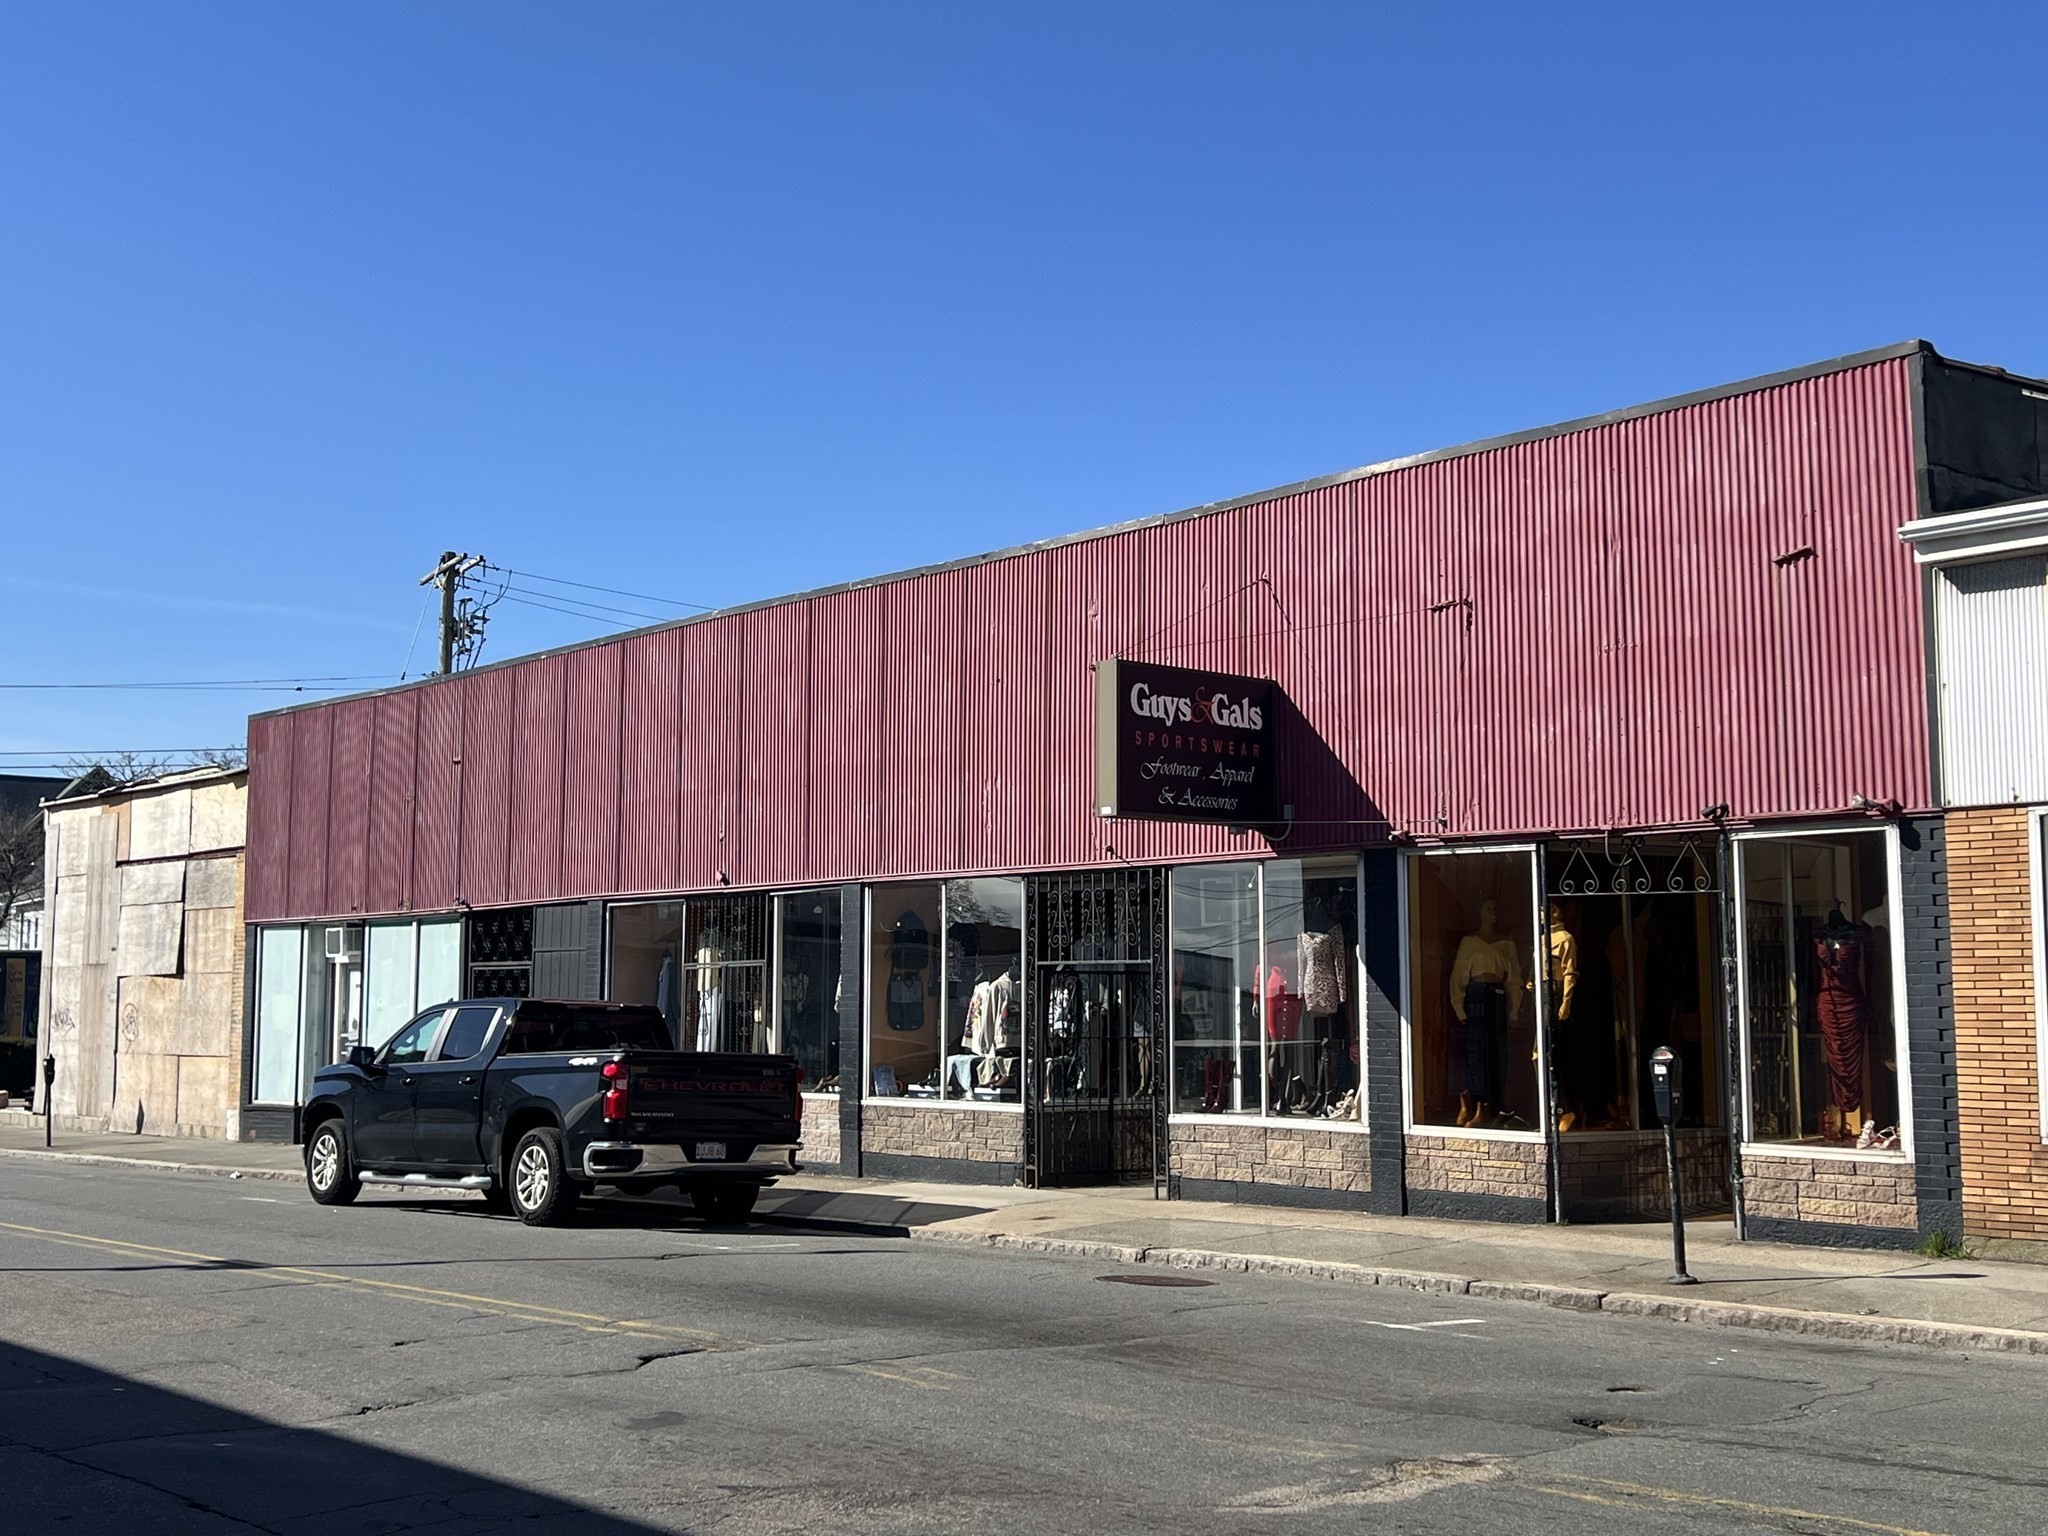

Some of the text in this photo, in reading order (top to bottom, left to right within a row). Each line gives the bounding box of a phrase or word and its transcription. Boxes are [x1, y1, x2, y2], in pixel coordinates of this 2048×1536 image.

[1130, 682, 1263, 730] Guys & Gals
[1135, 730, 1260, 758] SPORTSWEAR
[1209, 762, 1255, 787] Apparel
[1158, 786, 1239, 811] & Accessories
[643, 1079, 785, 1092] CHEVROLET
